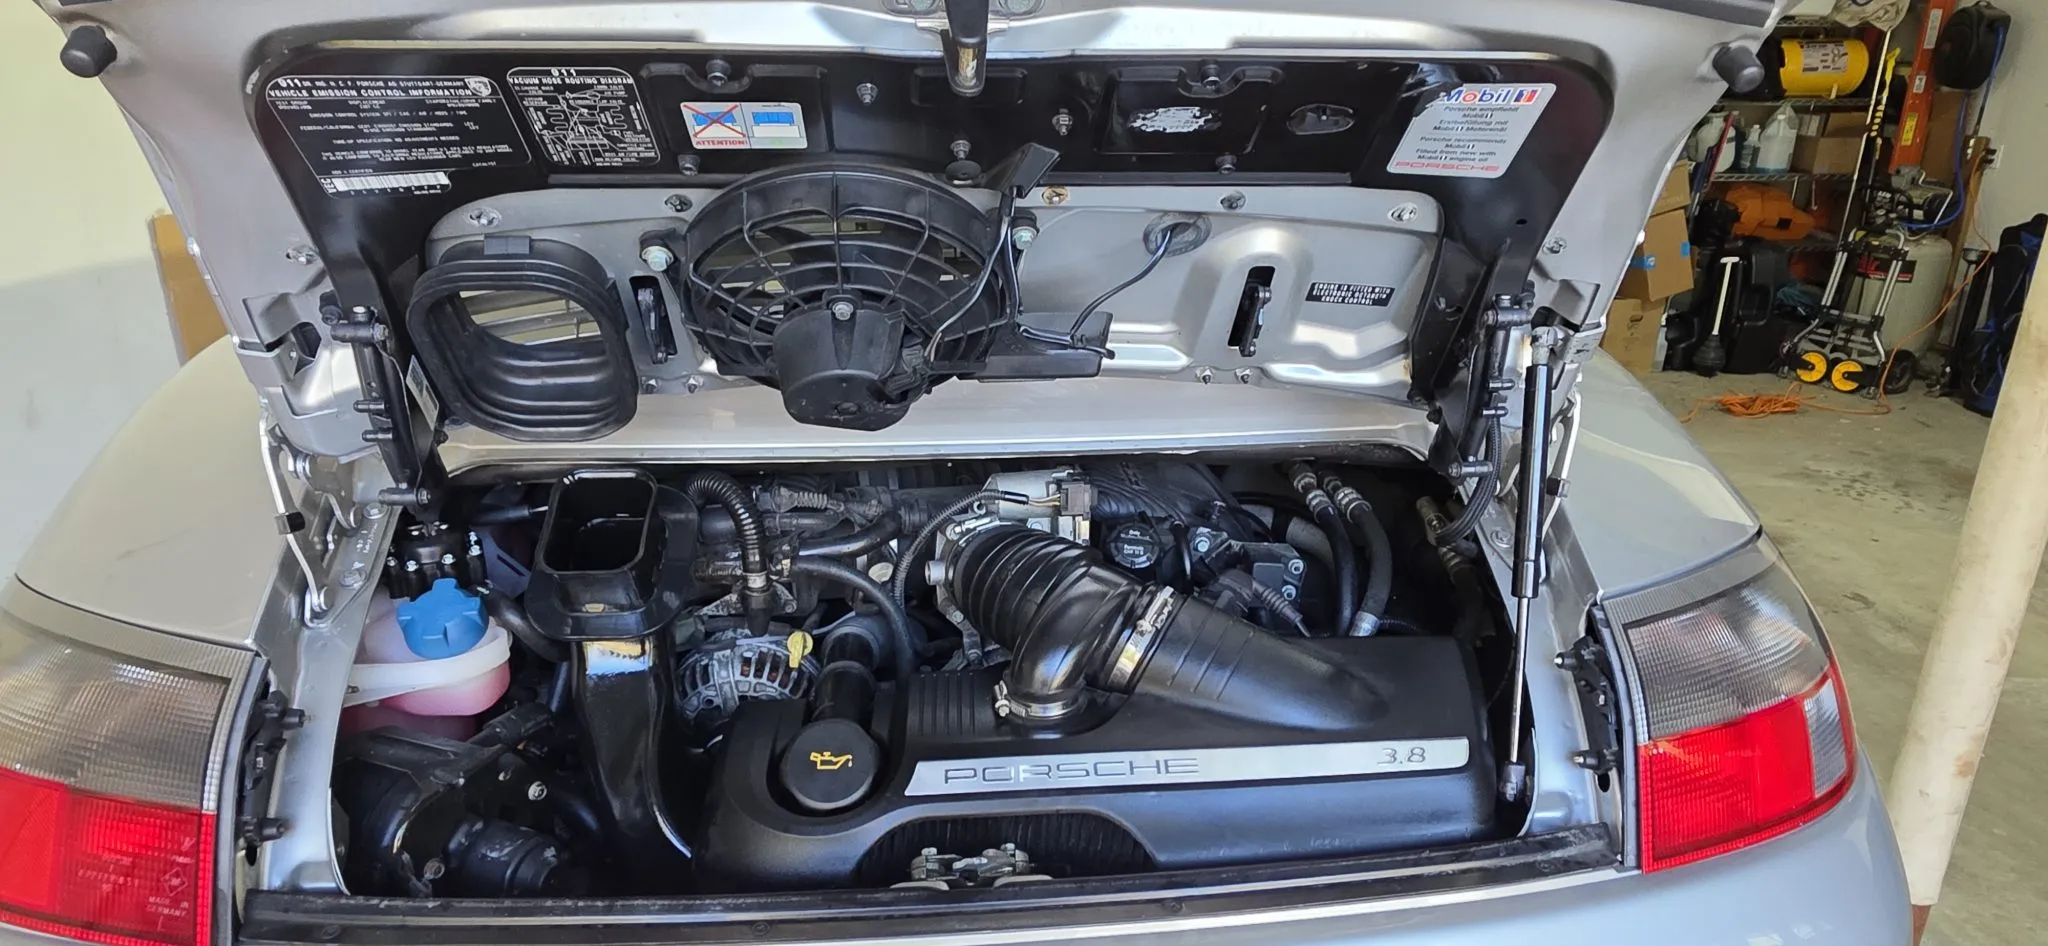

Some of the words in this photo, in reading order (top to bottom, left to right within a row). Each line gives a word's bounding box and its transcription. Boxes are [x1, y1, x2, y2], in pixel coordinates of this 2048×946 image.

[508, 77, 540, 85] VACUUM
[542, 77, 562, 85] HOSE
[565, 77, 598, 85] ROUTING
[600, 77, 633, 85] DIAGRAM
[268, 89, 309, 97] VEHICLE
[312, 89, 358, 97] EMISSION
[360, 89, 406, 97] CONTROL
[408, 89, 473, 97] INFORMATION
[1444, 87, 1511, 103] Mobil
[1395, 161, 1500, 172] PORSCHE
[1349, 284, 1373, 293] FITTED
[1374, 286, 1391, 294] WITH
[1344, 297, 1374, 306] CONTROL
[1376, 746, 1426, 765] 3.8
[944, 757, 1200, 785] PORSCHE
